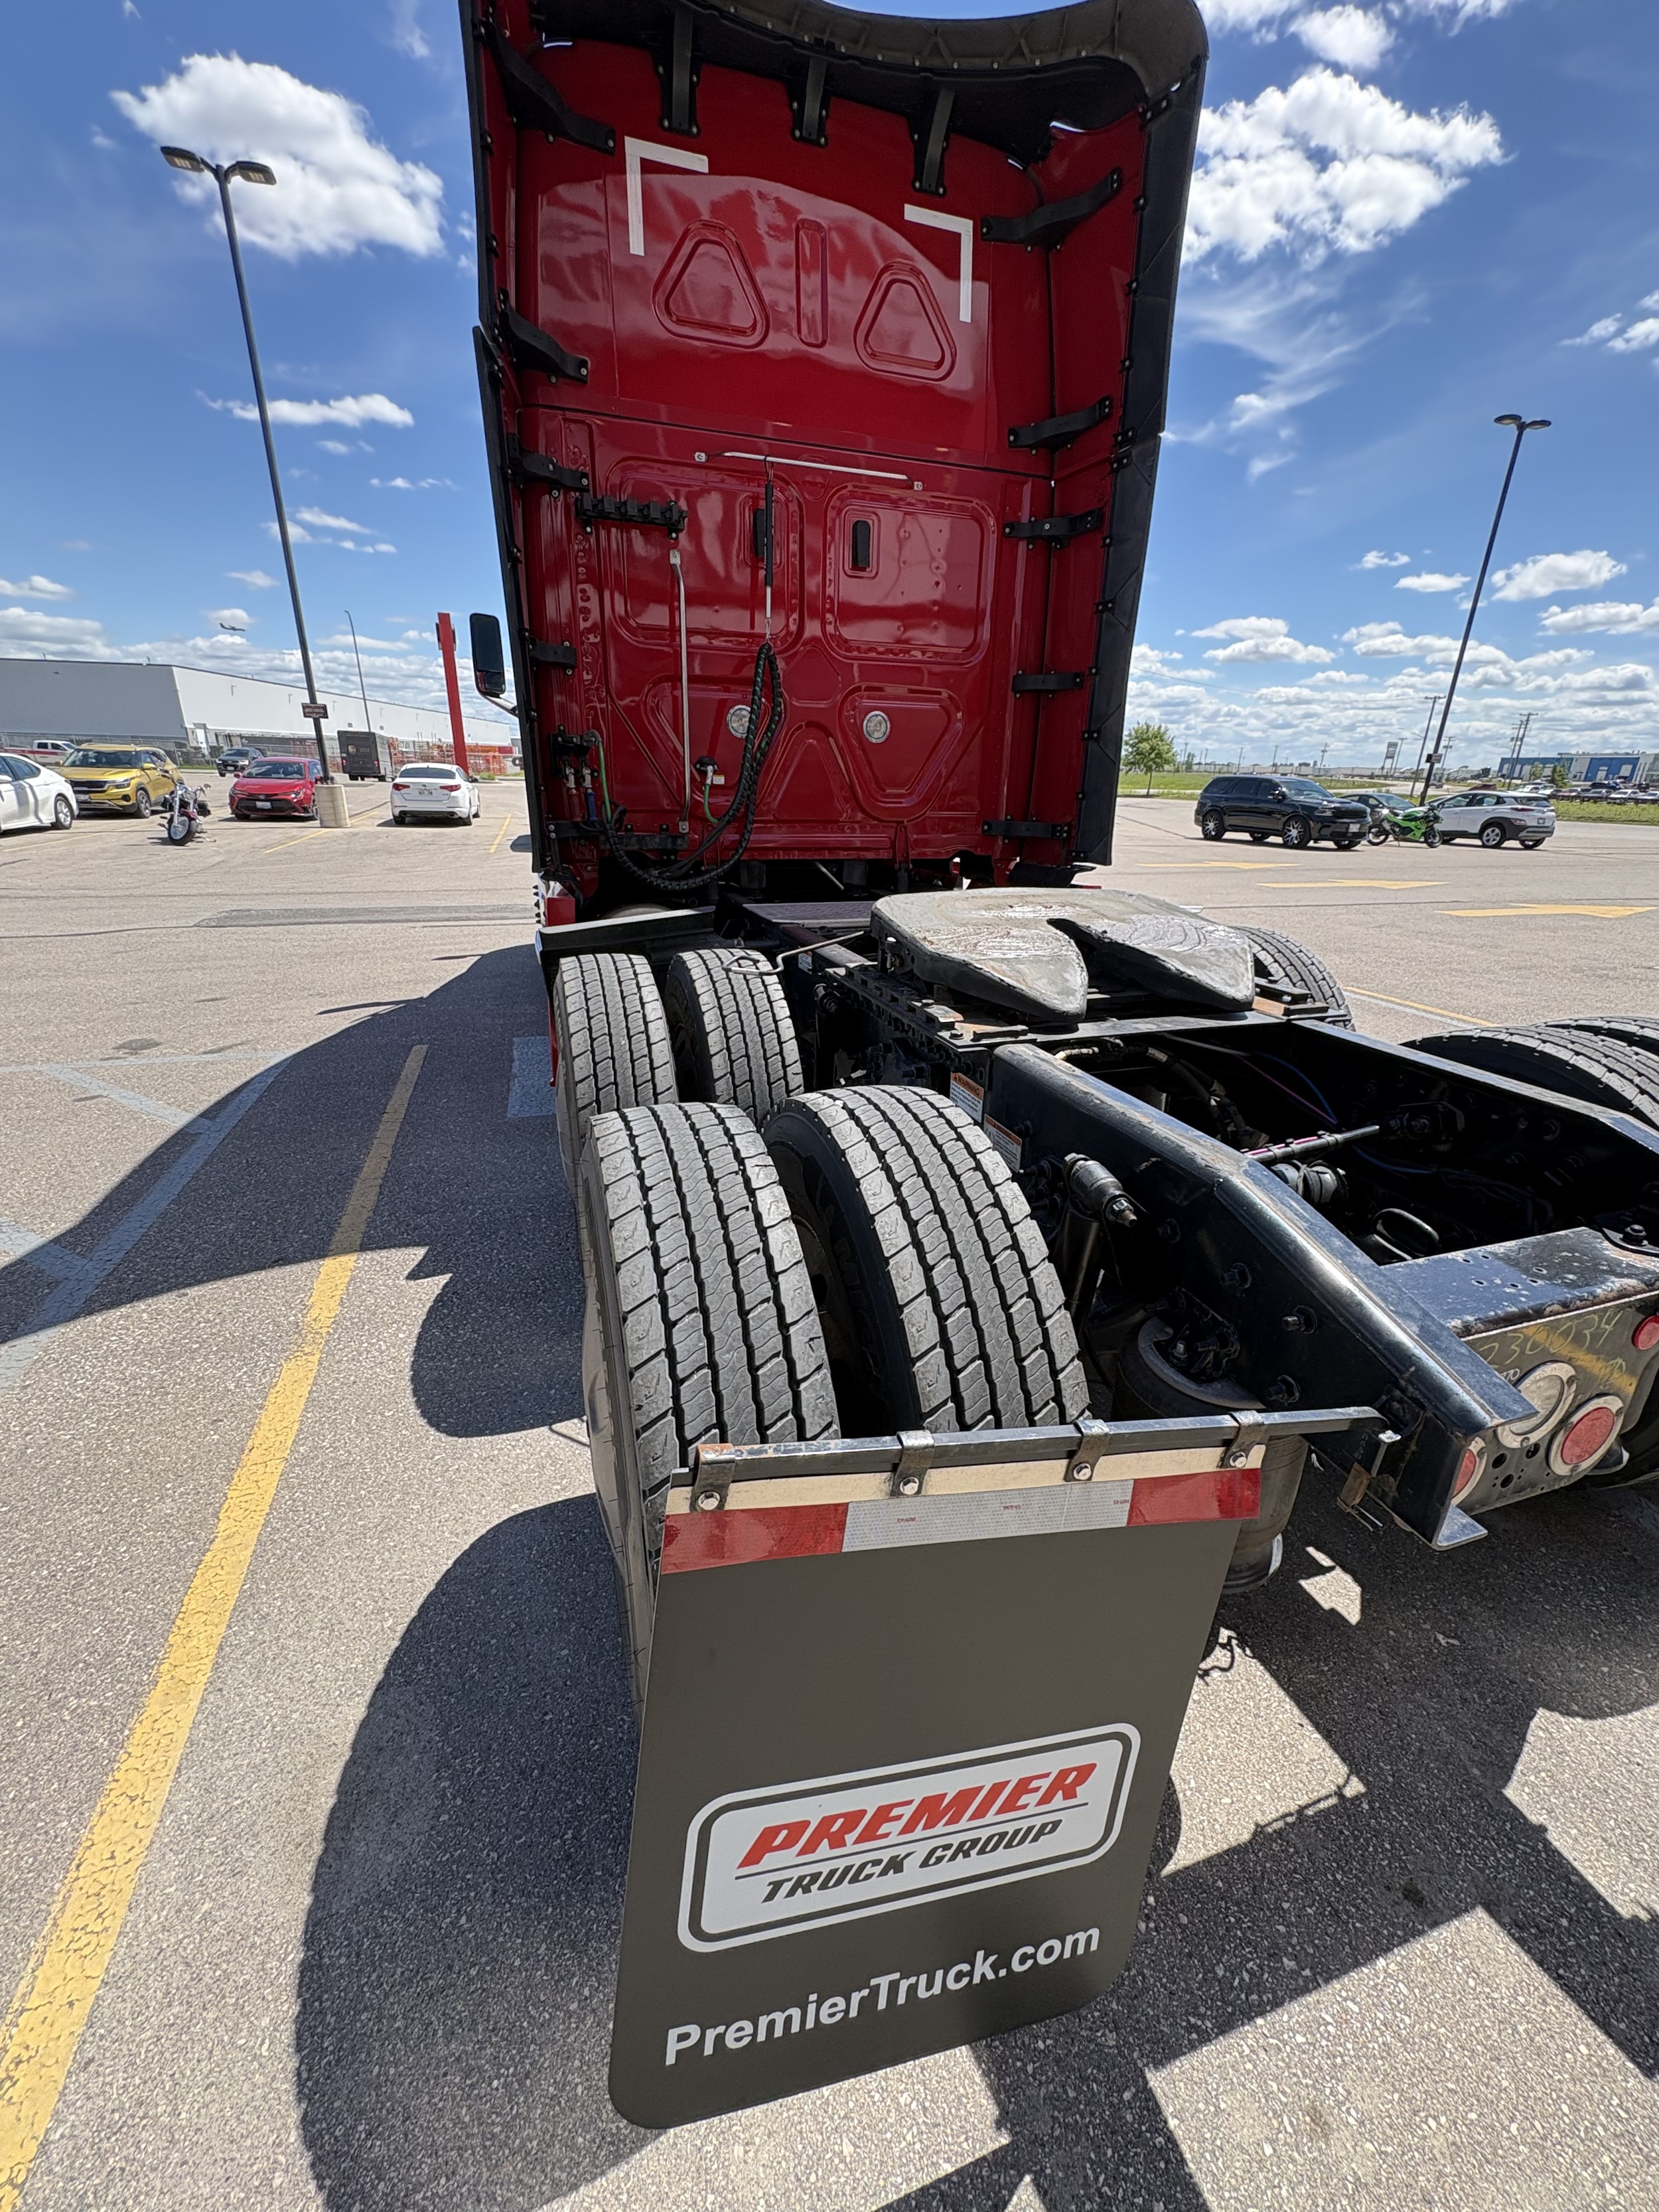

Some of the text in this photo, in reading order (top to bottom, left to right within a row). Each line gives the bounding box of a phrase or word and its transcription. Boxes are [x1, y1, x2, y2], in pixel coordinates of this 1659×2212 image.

[957, 1074, 980, 1096] WARNING
[737, 1762, 1098, 1869] PREMIER
[761, 1818, 1063, 1904] TRUCK GROUP
[664, 1927, 1101, 2067] PremierTruck.com
